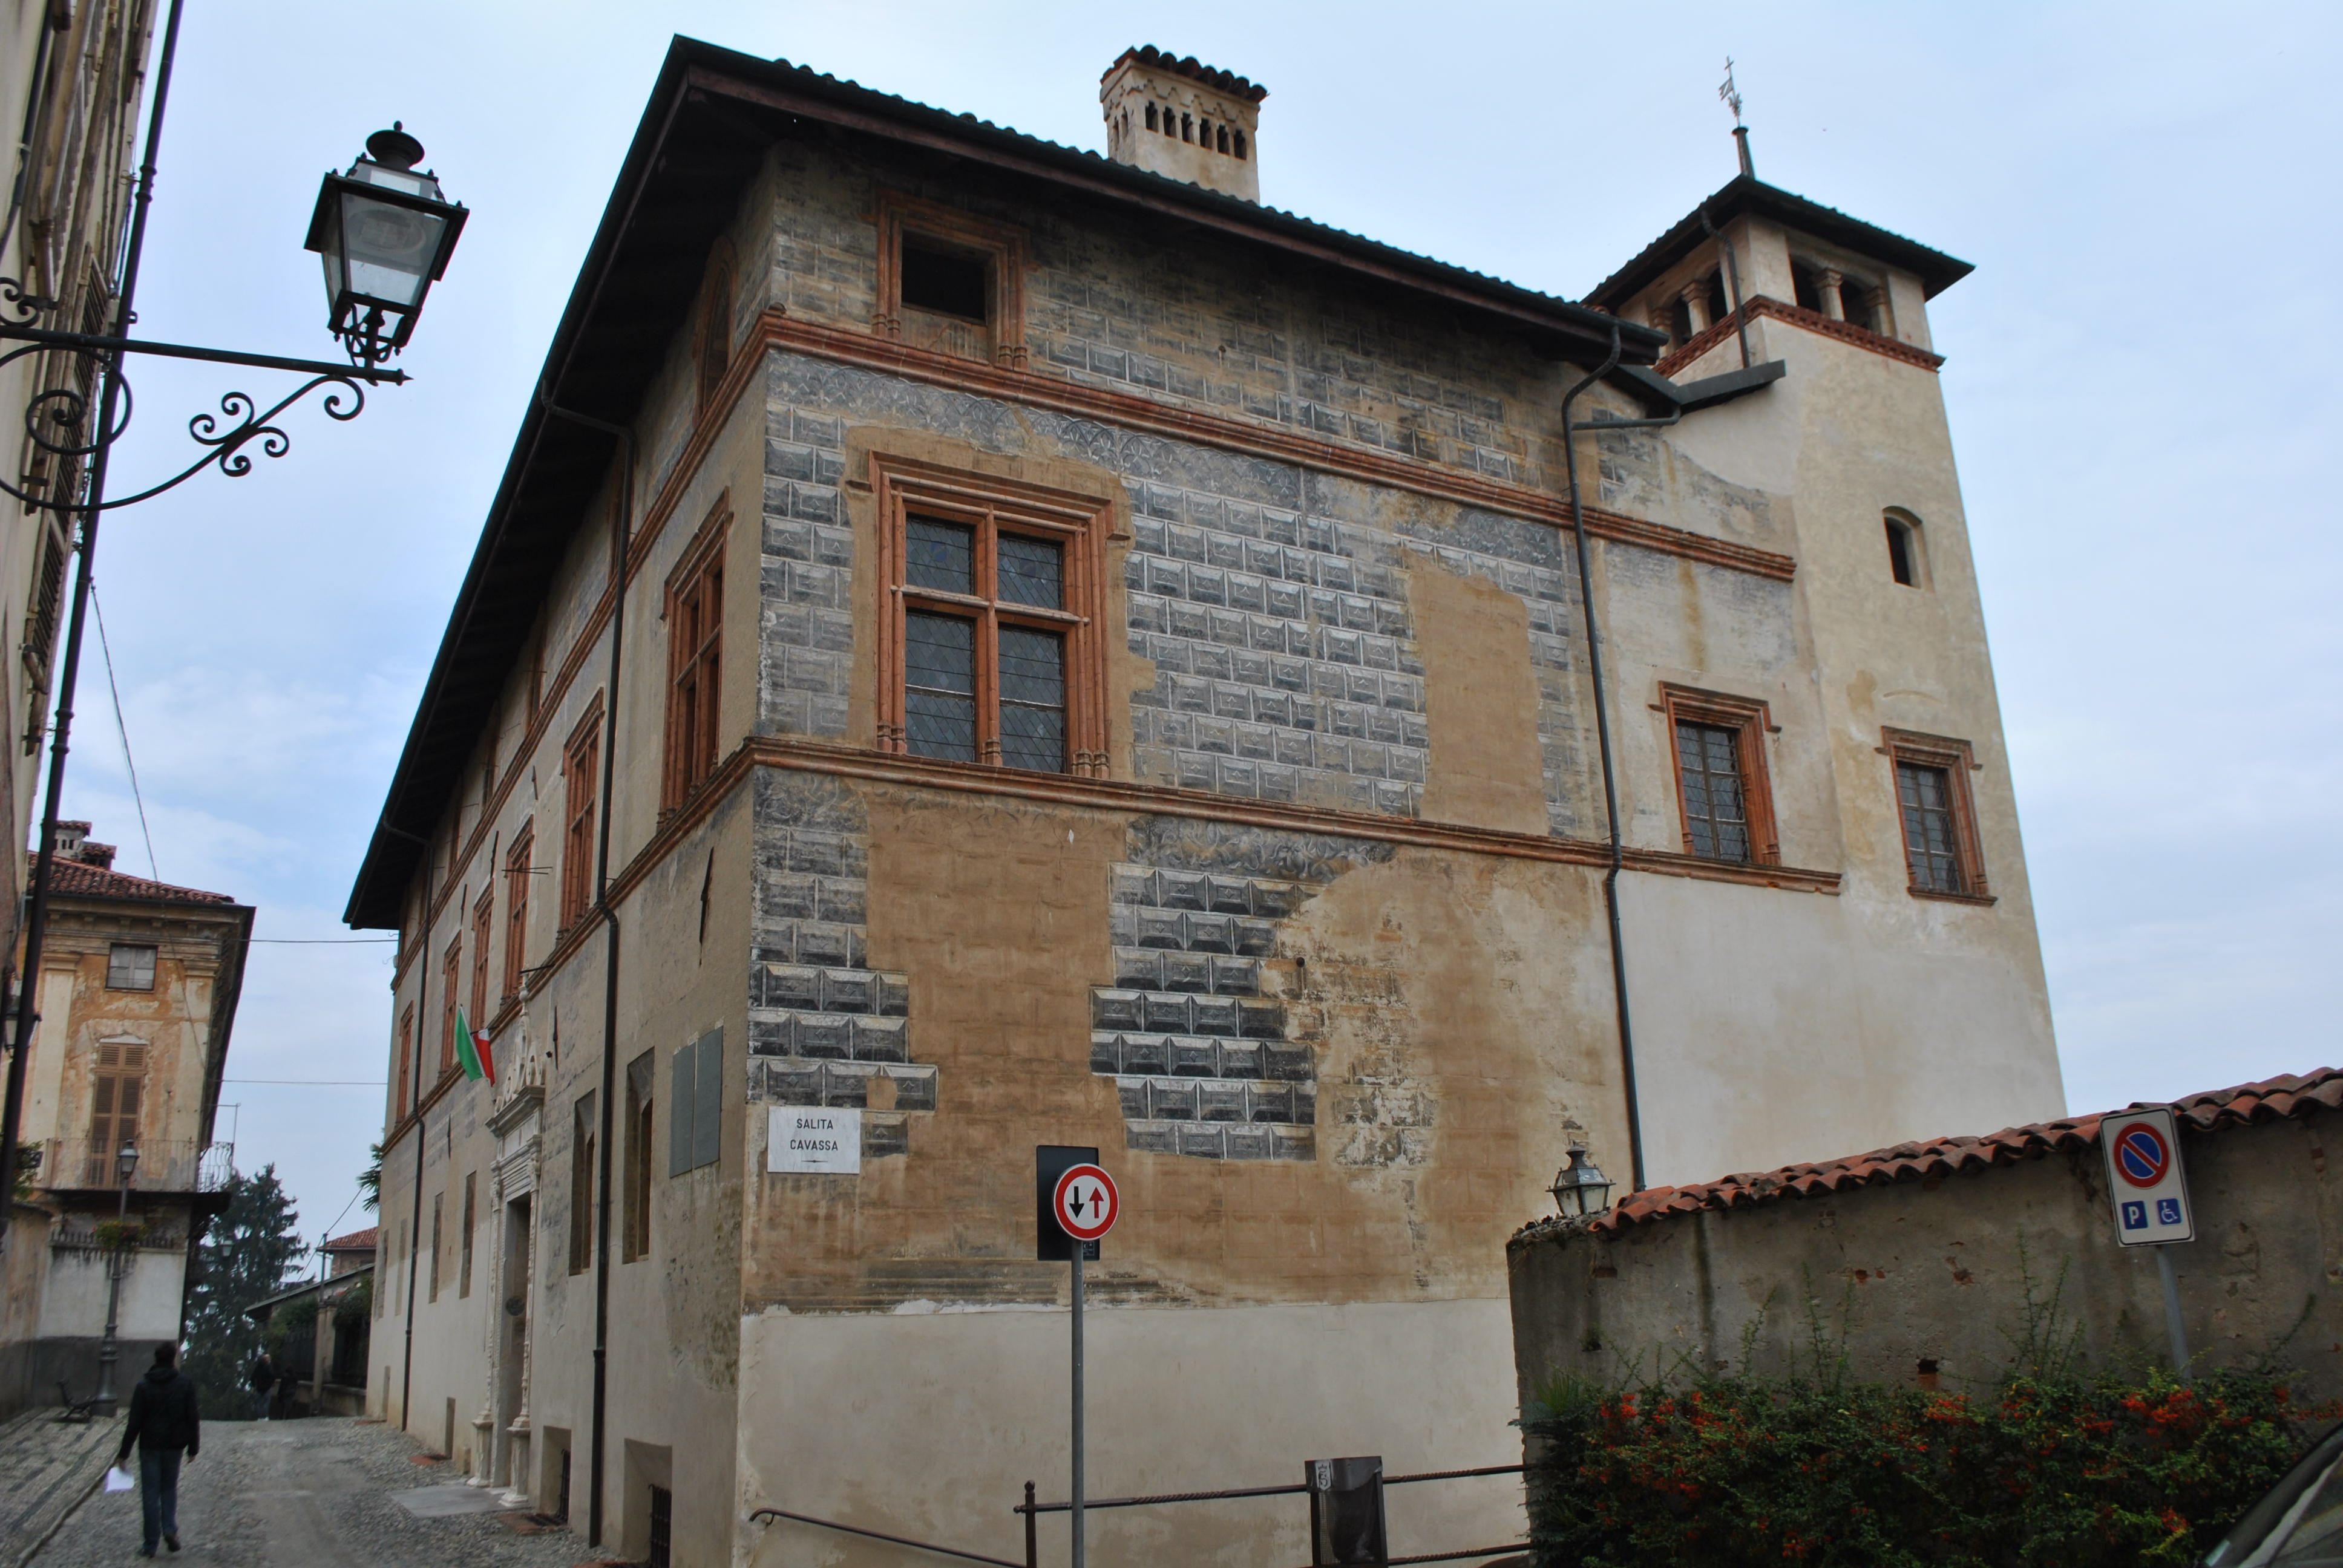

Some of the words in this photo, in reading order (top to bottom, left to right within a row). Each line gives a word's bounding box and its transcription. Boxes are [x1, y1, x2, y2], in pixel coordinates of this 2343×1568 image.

[796, 1119, 833, 1129] SALITA
[790, 1139, 838, 1151] CAVASSA
[2129, 1206, 2140, 1225] P
